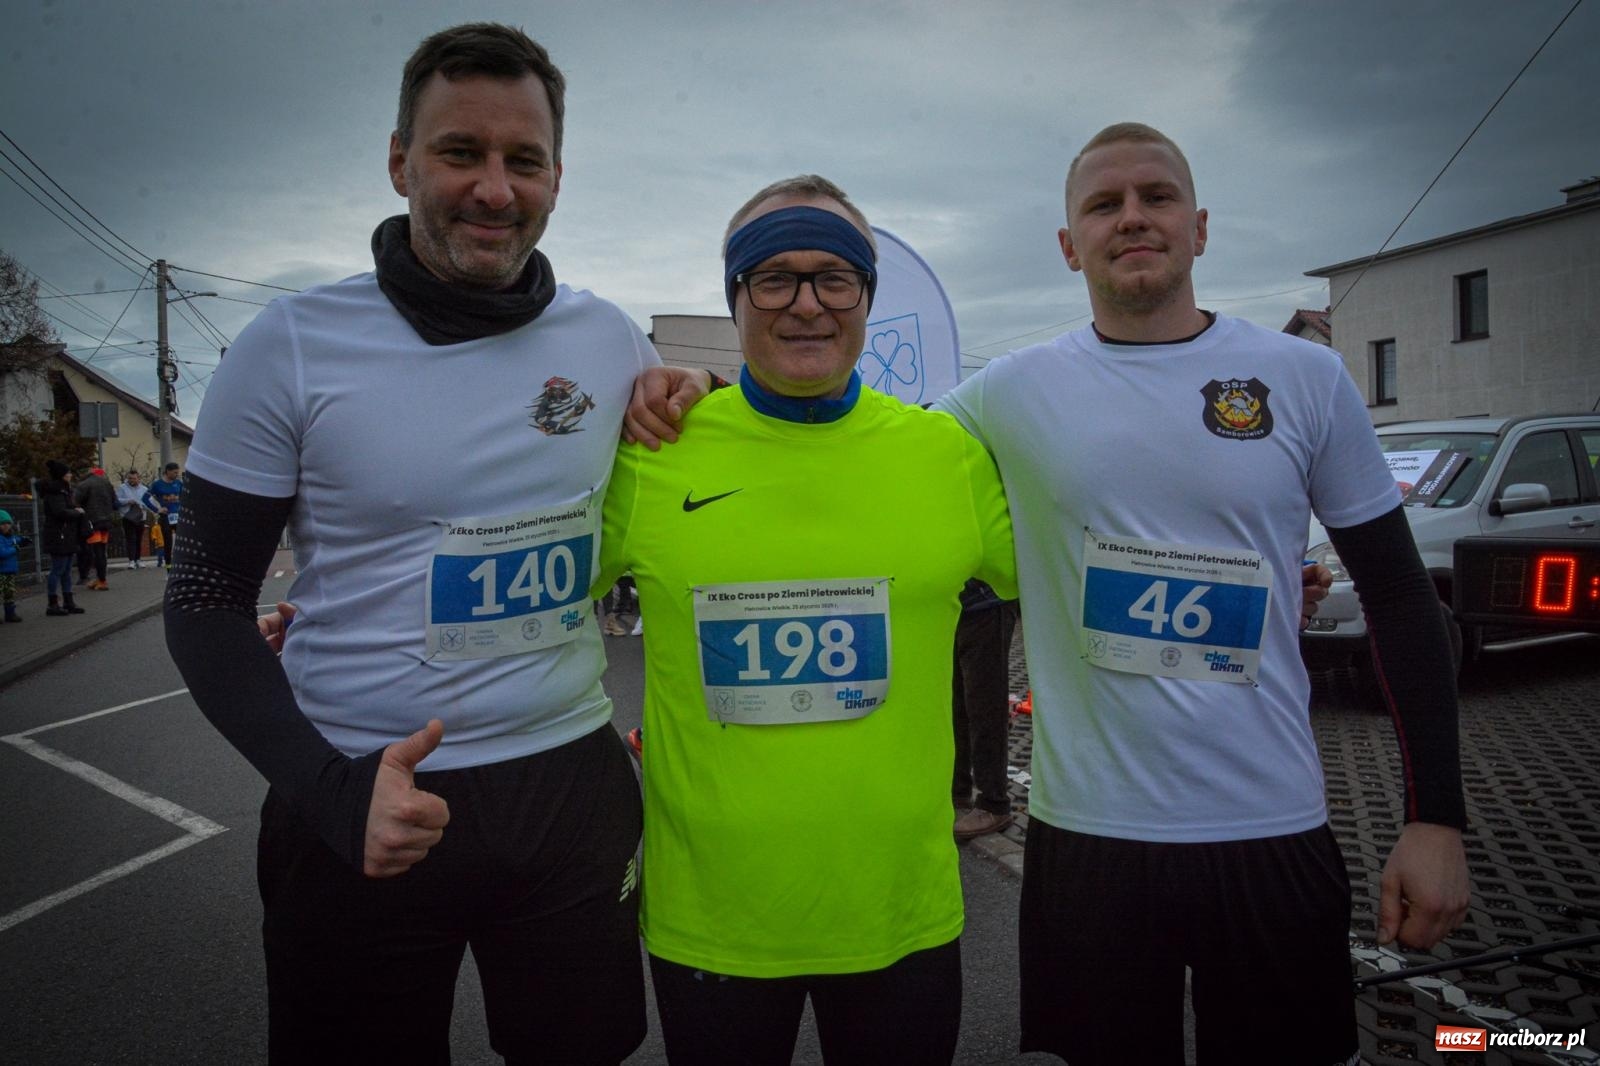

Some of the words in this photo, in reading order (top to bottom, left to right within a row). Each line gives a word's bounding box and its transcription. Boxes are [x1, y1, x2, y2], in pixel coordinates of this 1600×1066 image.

[1221, 381, 1248, 390] OSP
[457, 526, 474, 536] Eko
[476, 526, 504, 536] Cross
[505, 524, 515, 534] po
[516, 517, 538, 530] Ziemi
[538, 508, 587, 526] Pietrowickiej
[1098, 542, 1108, 551] IX
[1109, 543, 1125, 553] Eko
[1126, 545, 1153, 557] Cross
[1154, 549, 1167, 560] po
[1168, 550, 1197, 562] Ziemi
[1197, 553, 1260, 570] Pietrowickiej
[467, 544, 576, 616] 140
[707, 592, 718, 602] IX
[719, 592, 736, 601] Eko
[737, 590, 766, 601] Cross
[767, 592, 780, 603] po
[781, 588, 809, 599] Ziemi
[810, 586, 875, 598] Pietrowickiej
[1128, 579, 1212, 638] 46
[732, 619, 858, 680] 198
